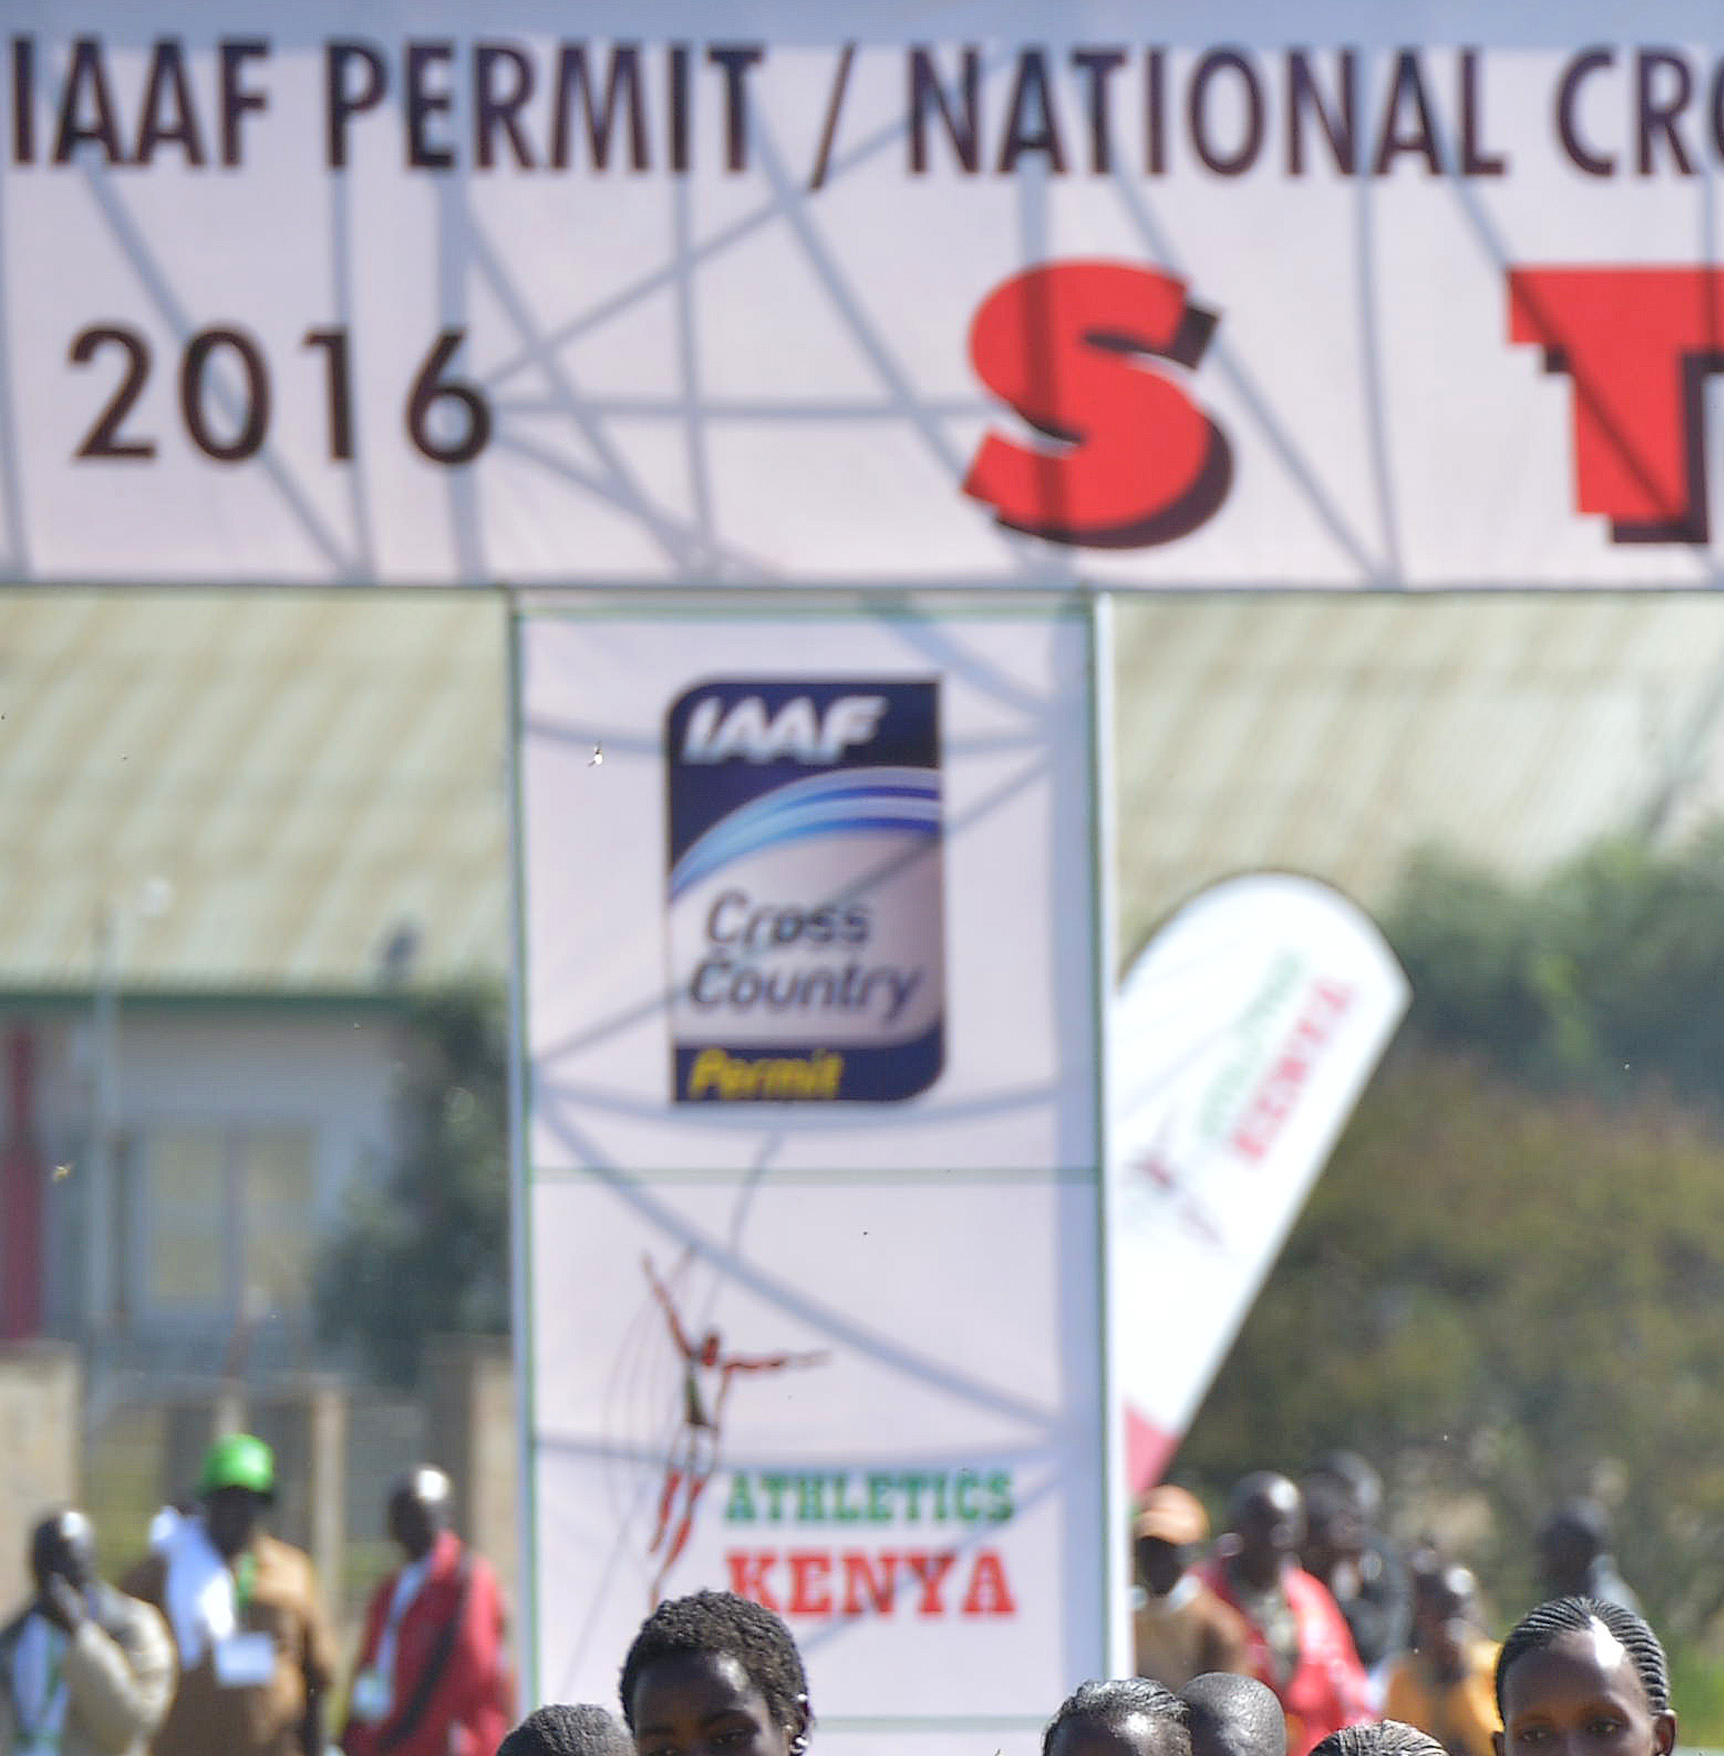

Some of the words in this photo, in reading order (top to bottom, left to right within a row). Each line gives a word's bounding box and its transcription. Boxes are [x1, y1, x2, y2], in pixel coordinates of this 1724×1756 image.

[12, 36, 272, 170] IAAF
[325, 38, 765, 173] PERMIT
[806, 42, 860, 192] /
[905, 44, 1510, 178] NATIONAL
[67, 320, 495, 466] 2016
[683, 694, 889, 765] IAAF
[705, 889, 872, 949] Cross
[686, 954, 923, 1019] Country
[687, 1046, 844, 1101] Permit
[723, 1468, 1016, 1528] ATHLETICS
[725, 1547, 1018, 1618] KENYA
